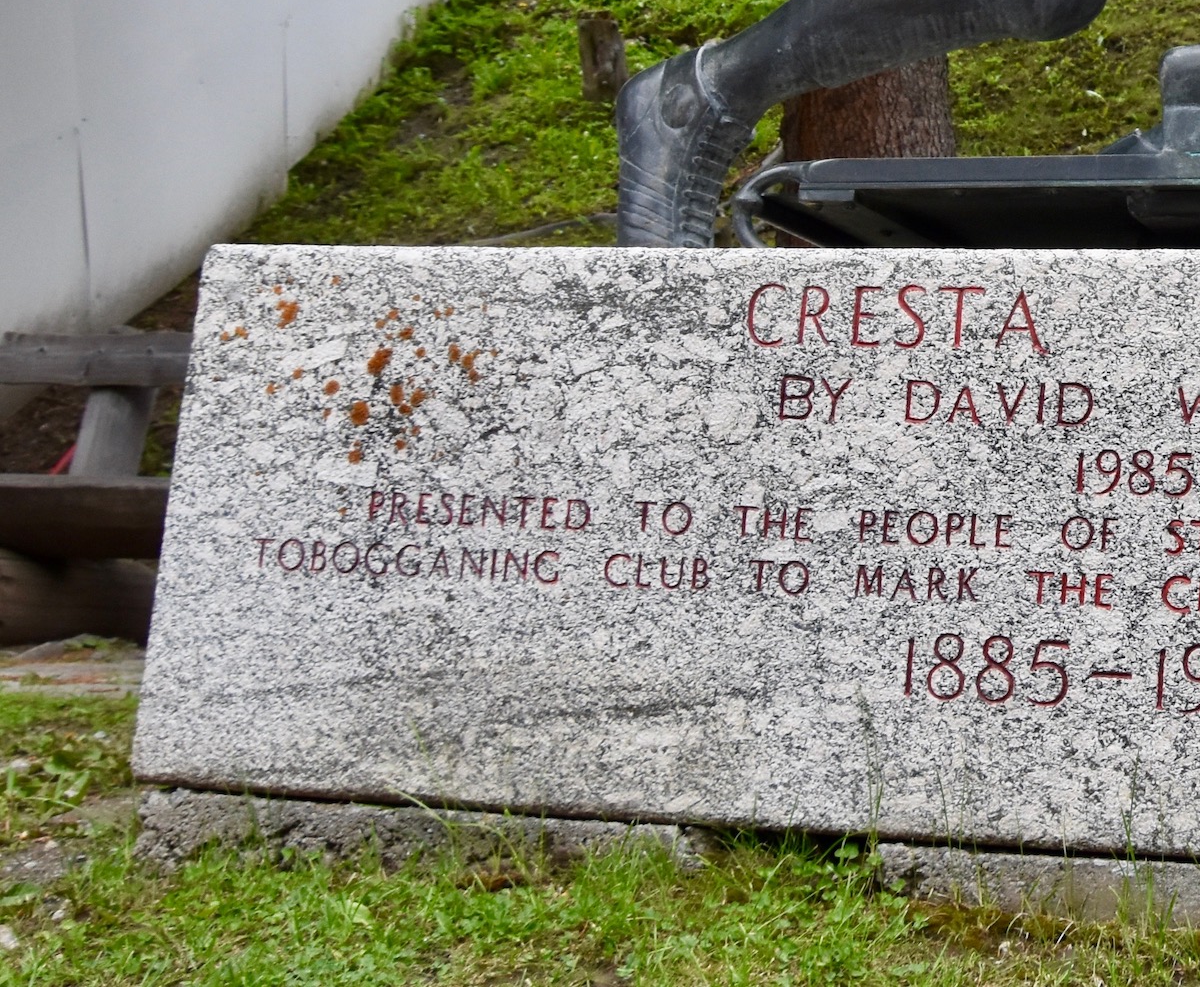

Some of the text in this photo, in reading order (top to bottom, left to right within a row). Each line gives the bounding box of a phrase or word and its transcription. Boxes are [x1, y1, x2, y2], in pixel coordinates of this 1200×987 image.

[747, 283, 1048, 356] CRESTA
[779, 376, 851, 421] BY
[904, 380, 1094, 427] DAVID
[1076, 450, 1193, 498] 1985
[369, 491, 591, 531] PRESENTED
[635, 500, 693, 538] TO
[733, 503, 816, 543] THE
[858, 510, 1013, 549] PEOPLE
[1061, 514, 1119, 552] OF
[255, 537, 561, 585] TOBOGGANING
[604, 554, 708, 590] CLUB
[750, 559, 811, 596] TO
[854, 565, 977, 602] MARK
[1028, 570, 1114, 611] THE
